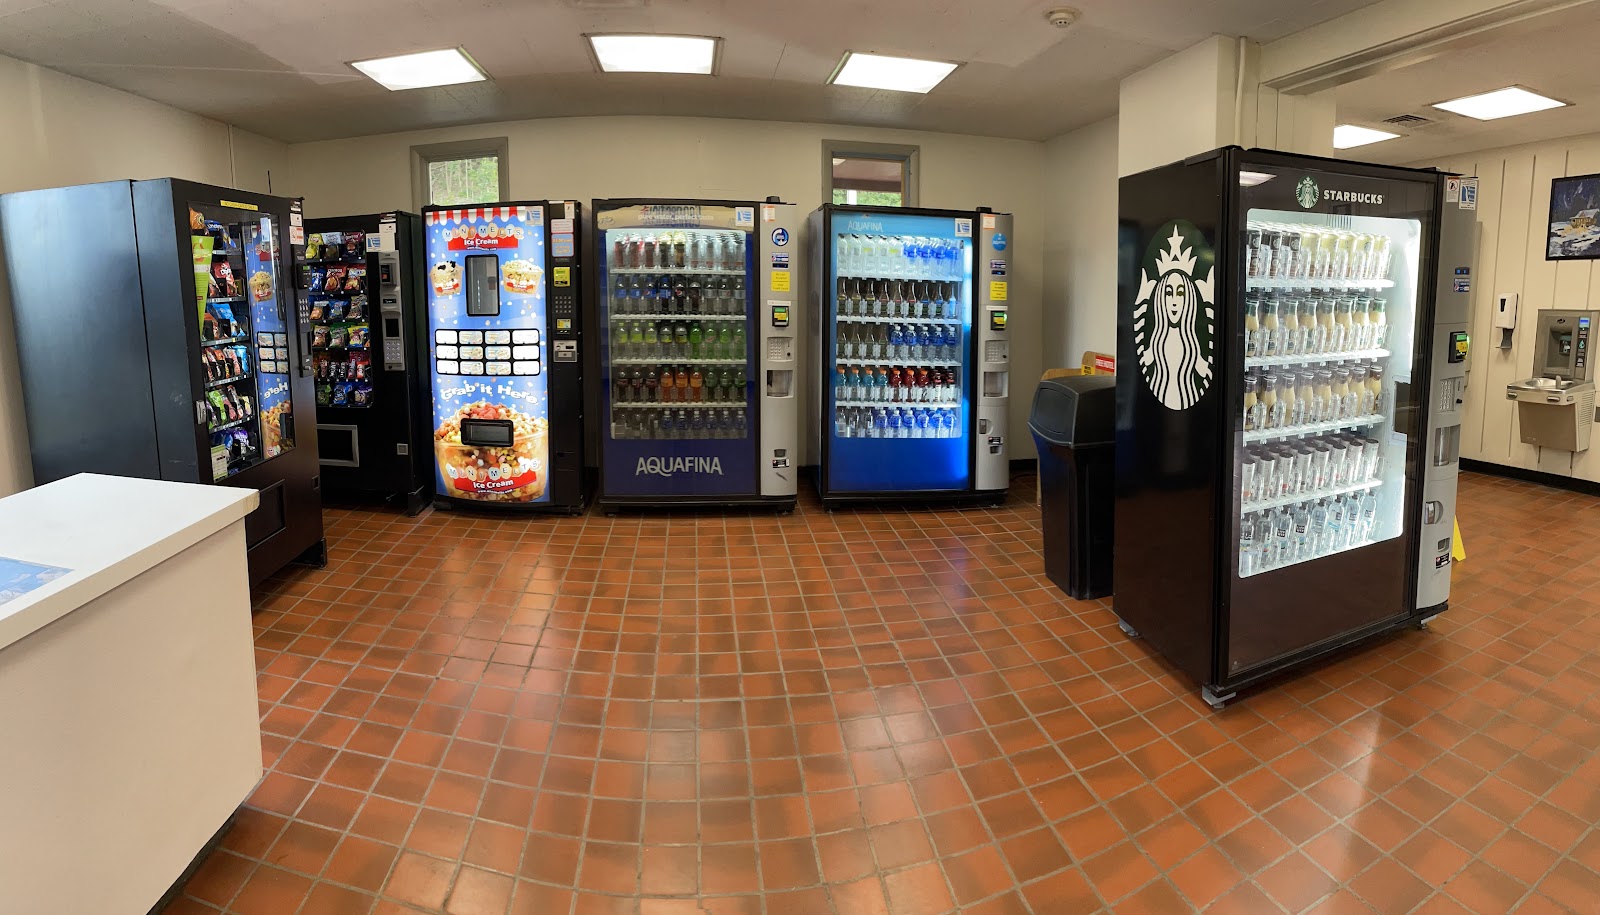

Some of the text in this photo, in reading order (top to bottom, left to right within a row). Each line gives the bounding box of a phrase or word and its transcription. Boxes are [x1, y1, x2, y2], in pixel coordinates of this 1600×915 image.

[1323, 189, 1384, 205] STARBUCKS
[445, 226, 520, 237] MINI MELTS
[847, 219, 884, 233] AQUAFINA
[475, 238, 498, 246] Cream
[440, 383, 538, 405] Grab it Here
[490, 460, 538, 478] MELTS
[635, 456, 724, 477] AQUAFINA
[473, 479, 514, 489] Ice Cream
